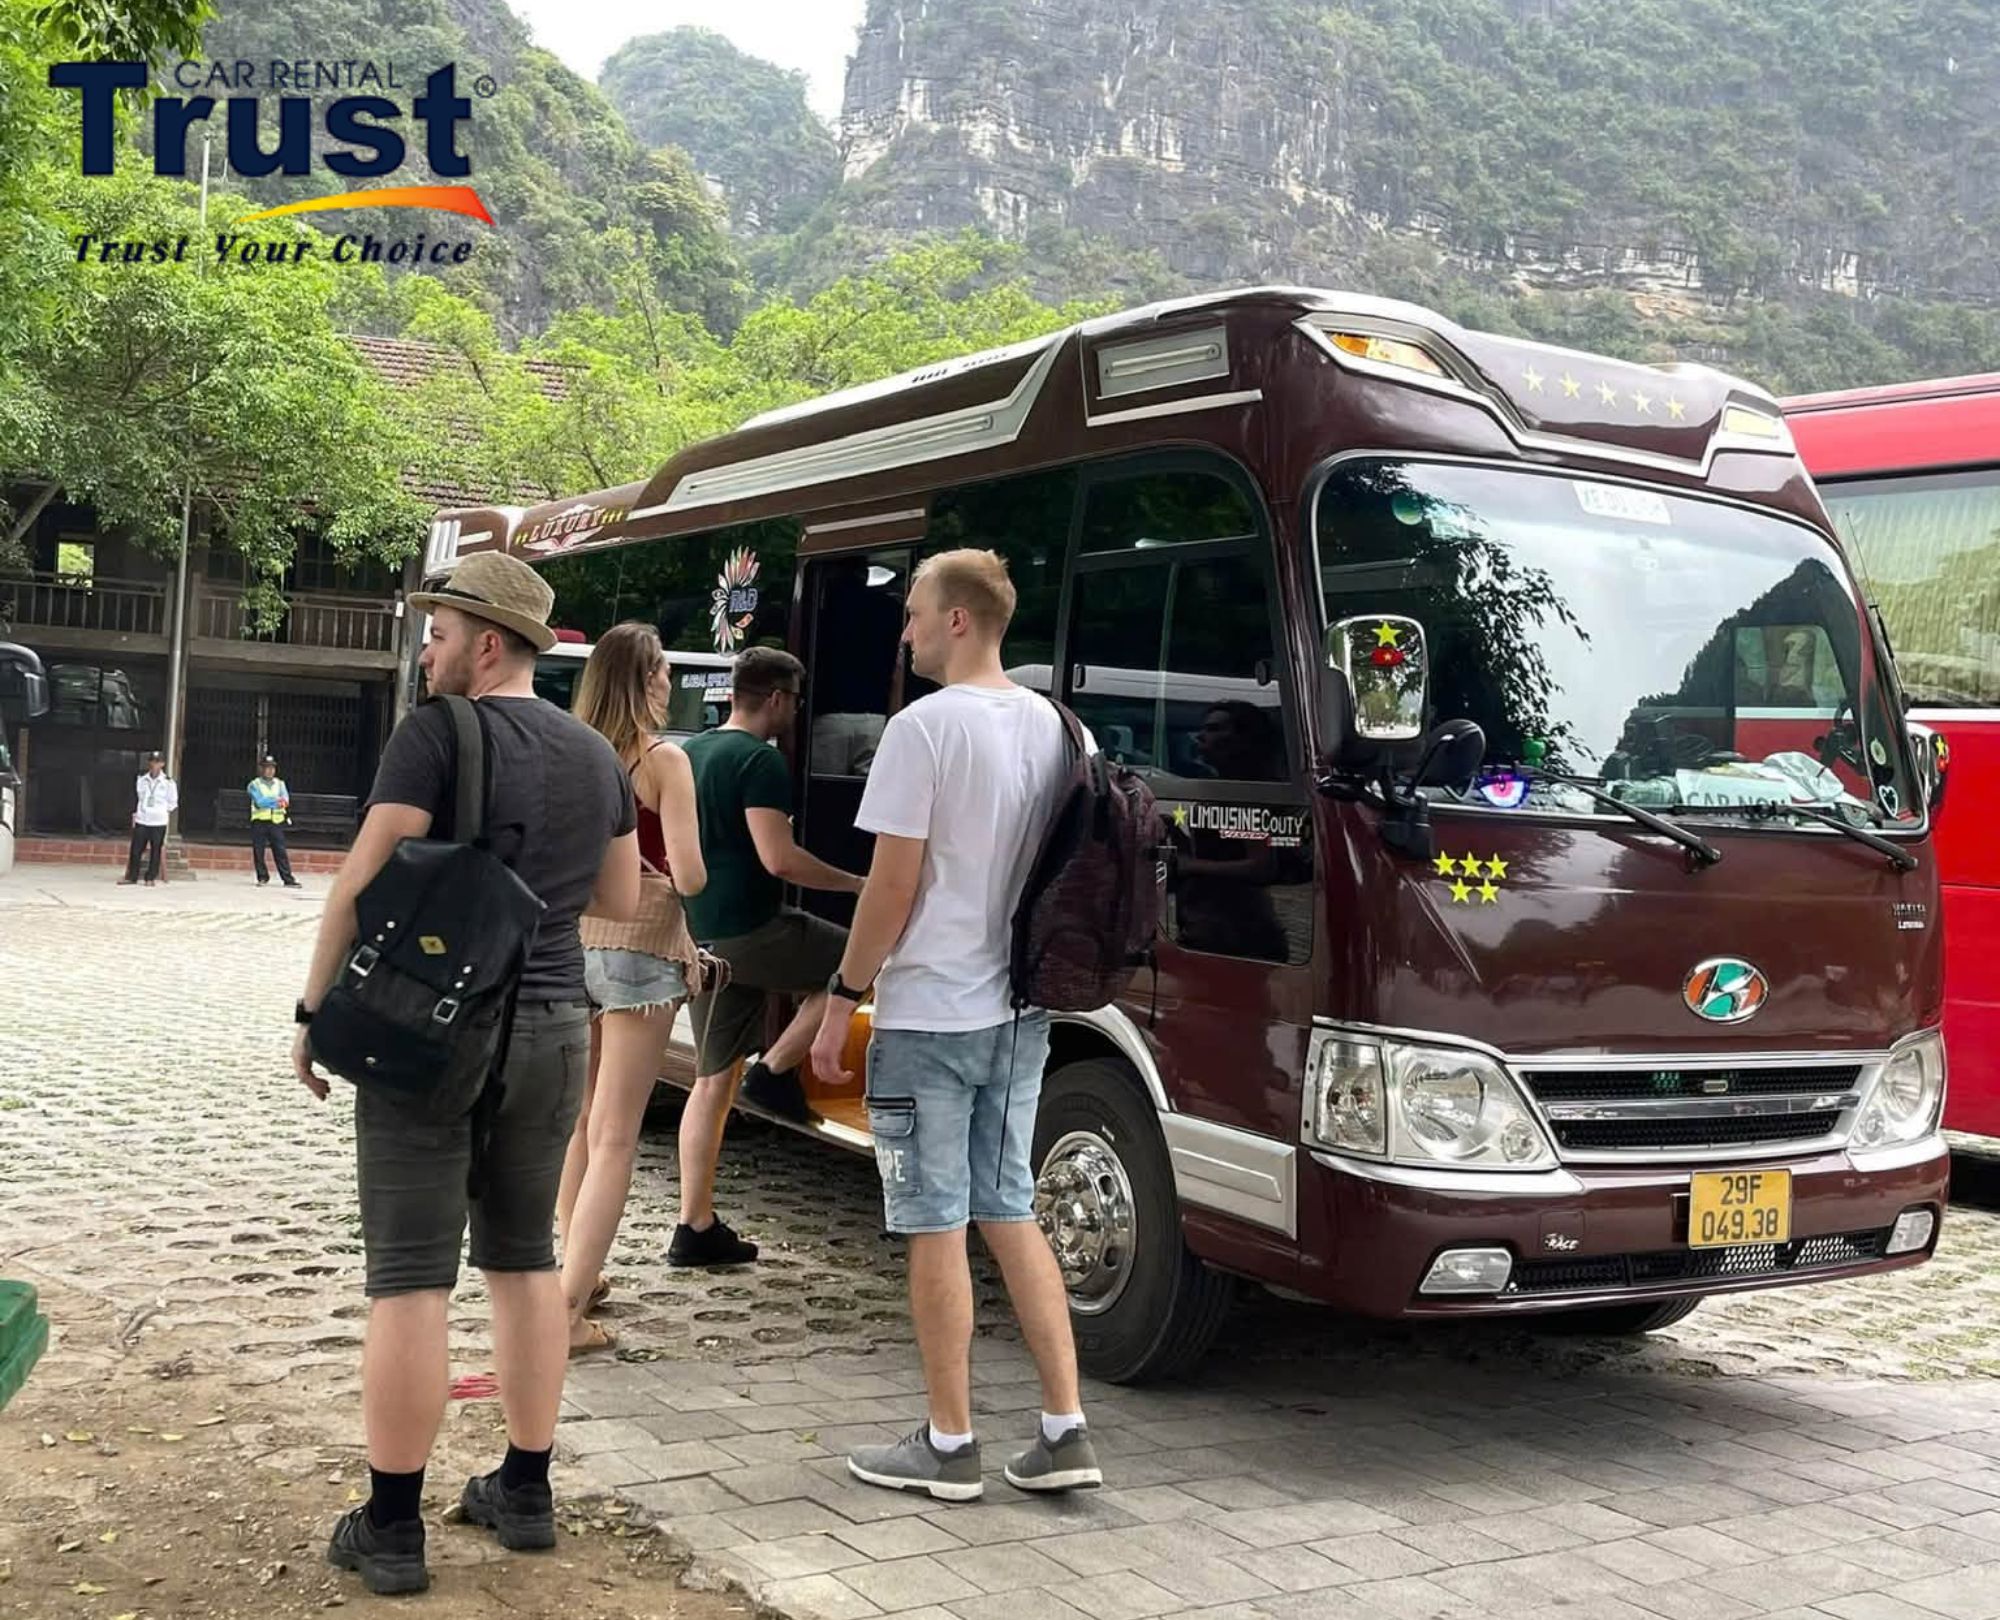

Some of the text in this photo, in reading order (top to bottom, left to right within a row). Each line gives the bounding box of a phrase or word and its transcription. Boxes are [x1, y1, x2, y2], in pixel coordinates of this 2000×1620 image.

[529, 508, 607, 543] LUXURY
[1719, 1174, 1763, 1206] 29F
[1701, 1207, 1779, 1242] 049.38
